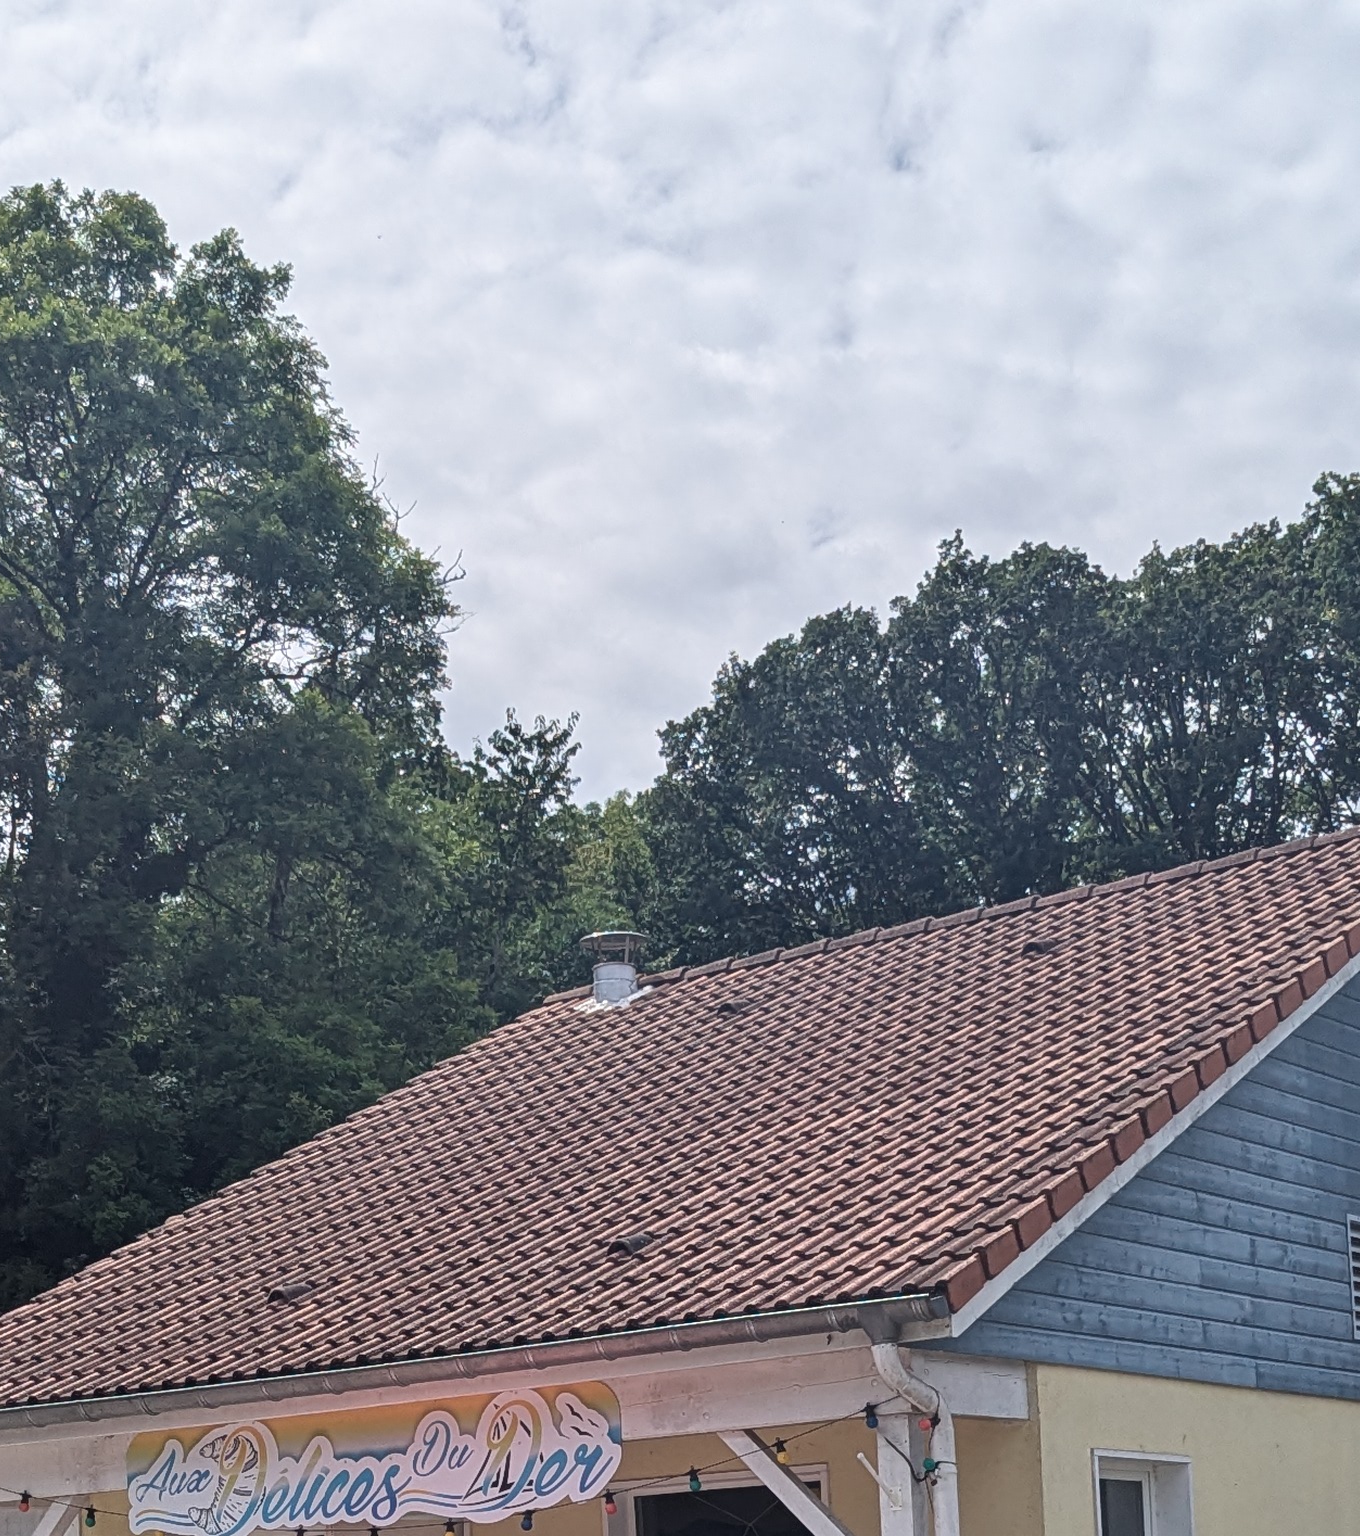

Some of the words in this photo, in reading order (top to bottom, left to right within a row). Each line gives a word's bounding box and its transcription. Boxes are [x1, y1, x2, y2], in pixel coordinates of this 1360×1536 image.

[136, 1449, 214, 1503] Aux
[413, 1420, 474, 1477] Du
[480, 1399, 614, 1513] Der
